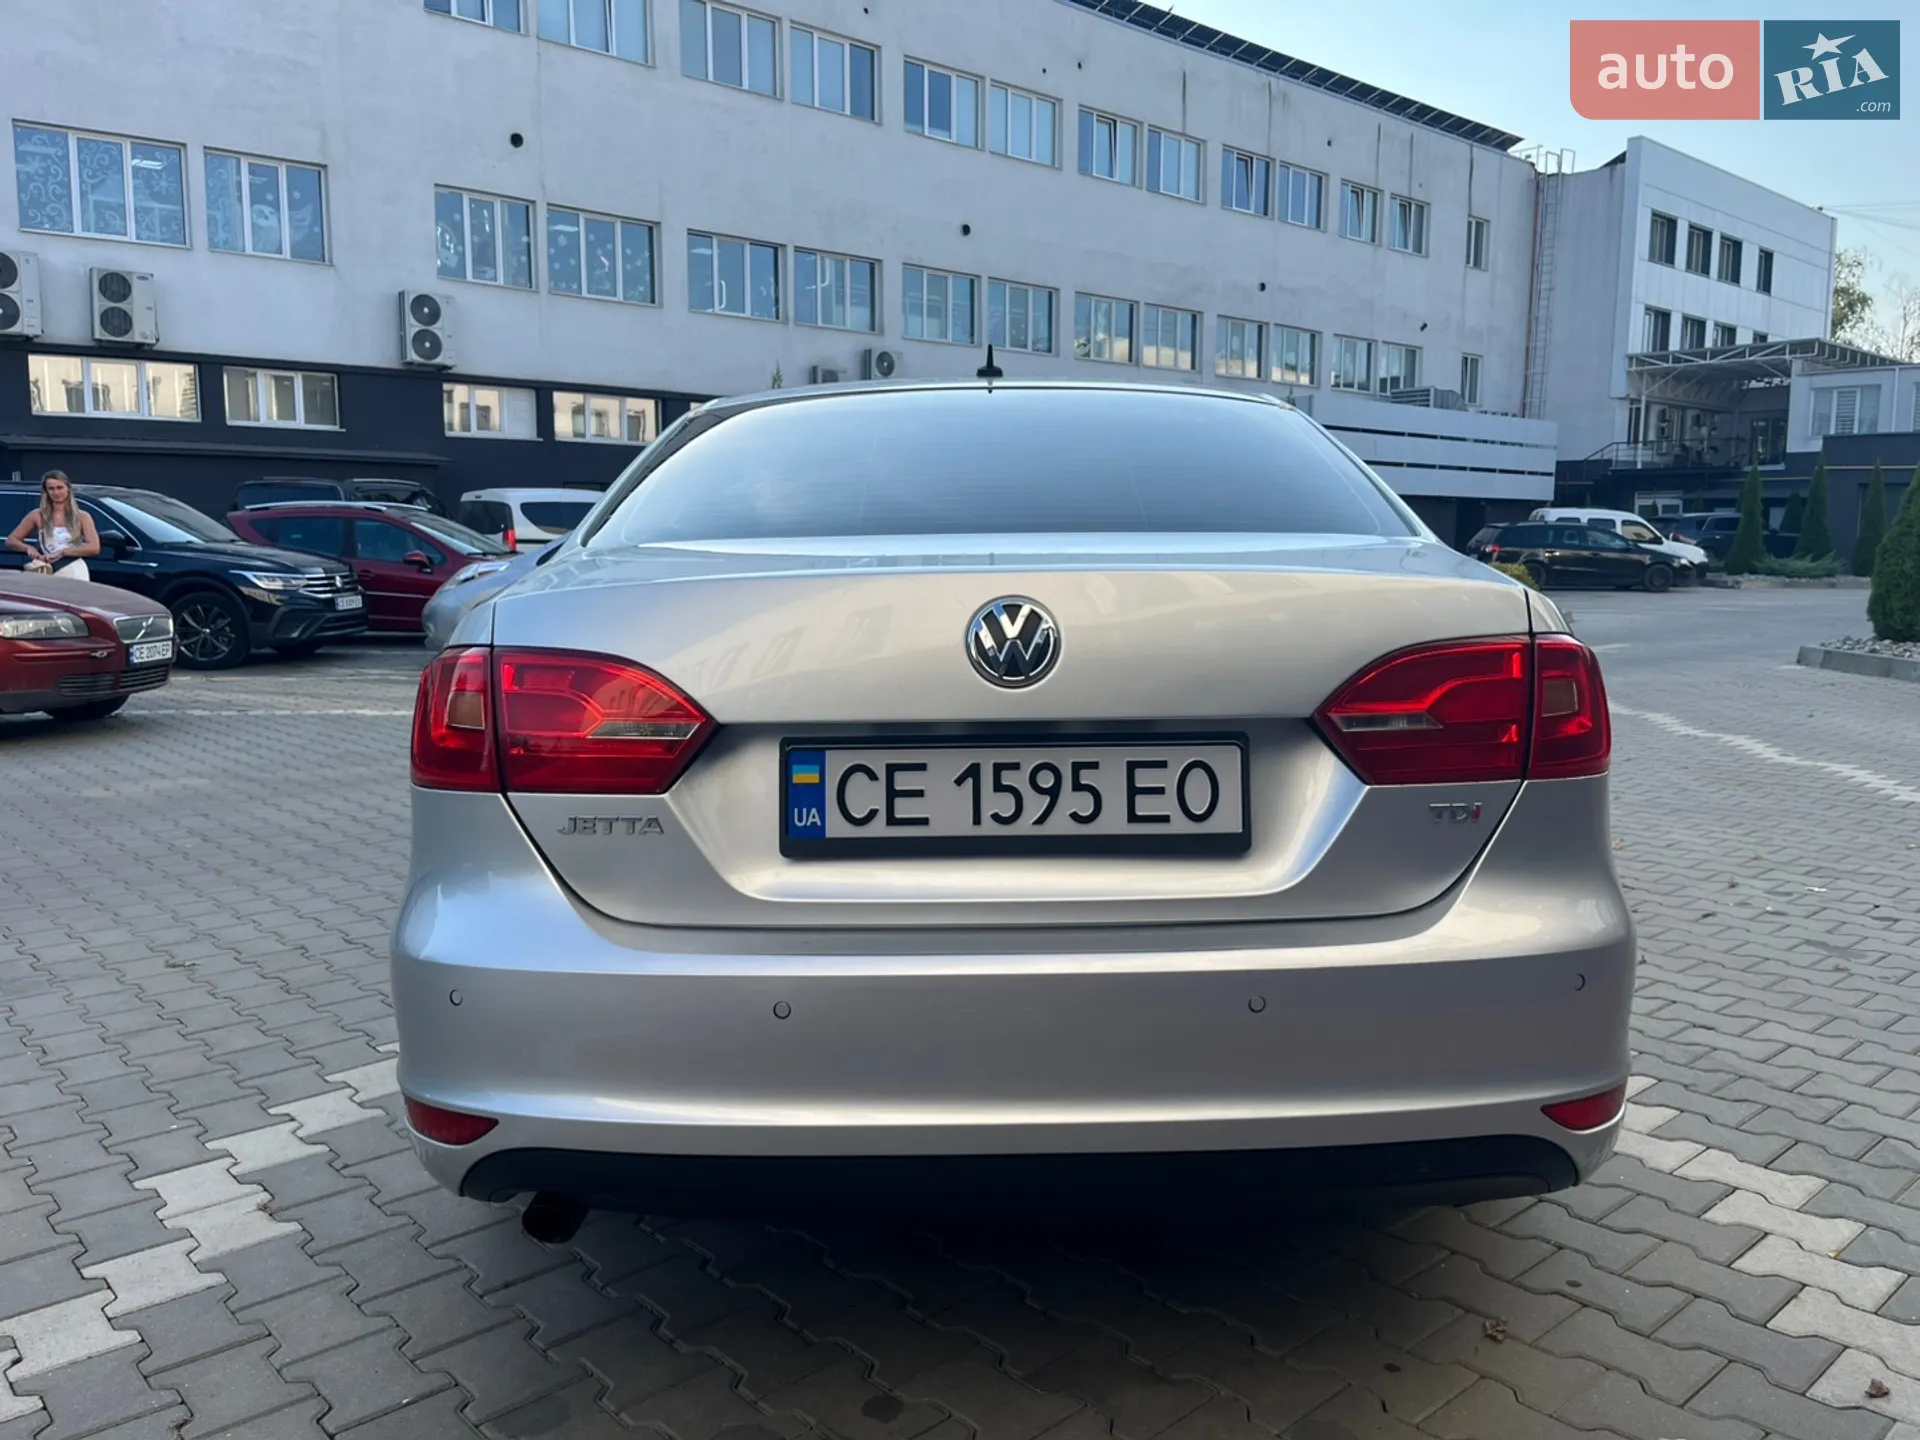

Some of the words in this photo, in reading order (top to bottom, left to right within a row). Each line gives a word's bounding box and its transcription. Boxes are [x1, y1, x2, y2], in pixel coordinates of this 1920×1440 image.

[134, 645, 145, 660] CE
[161, 642, 170, 657] EP
[836, 762, 930, 827] CE
[953, 760, 1103, 826] 1595
[1125, 758, 1220, 824] EO
[794, 807, 821, 827] UA
[1429, 802, 1482, 823] TDI
[557, 815, 665, 835] JETTA
